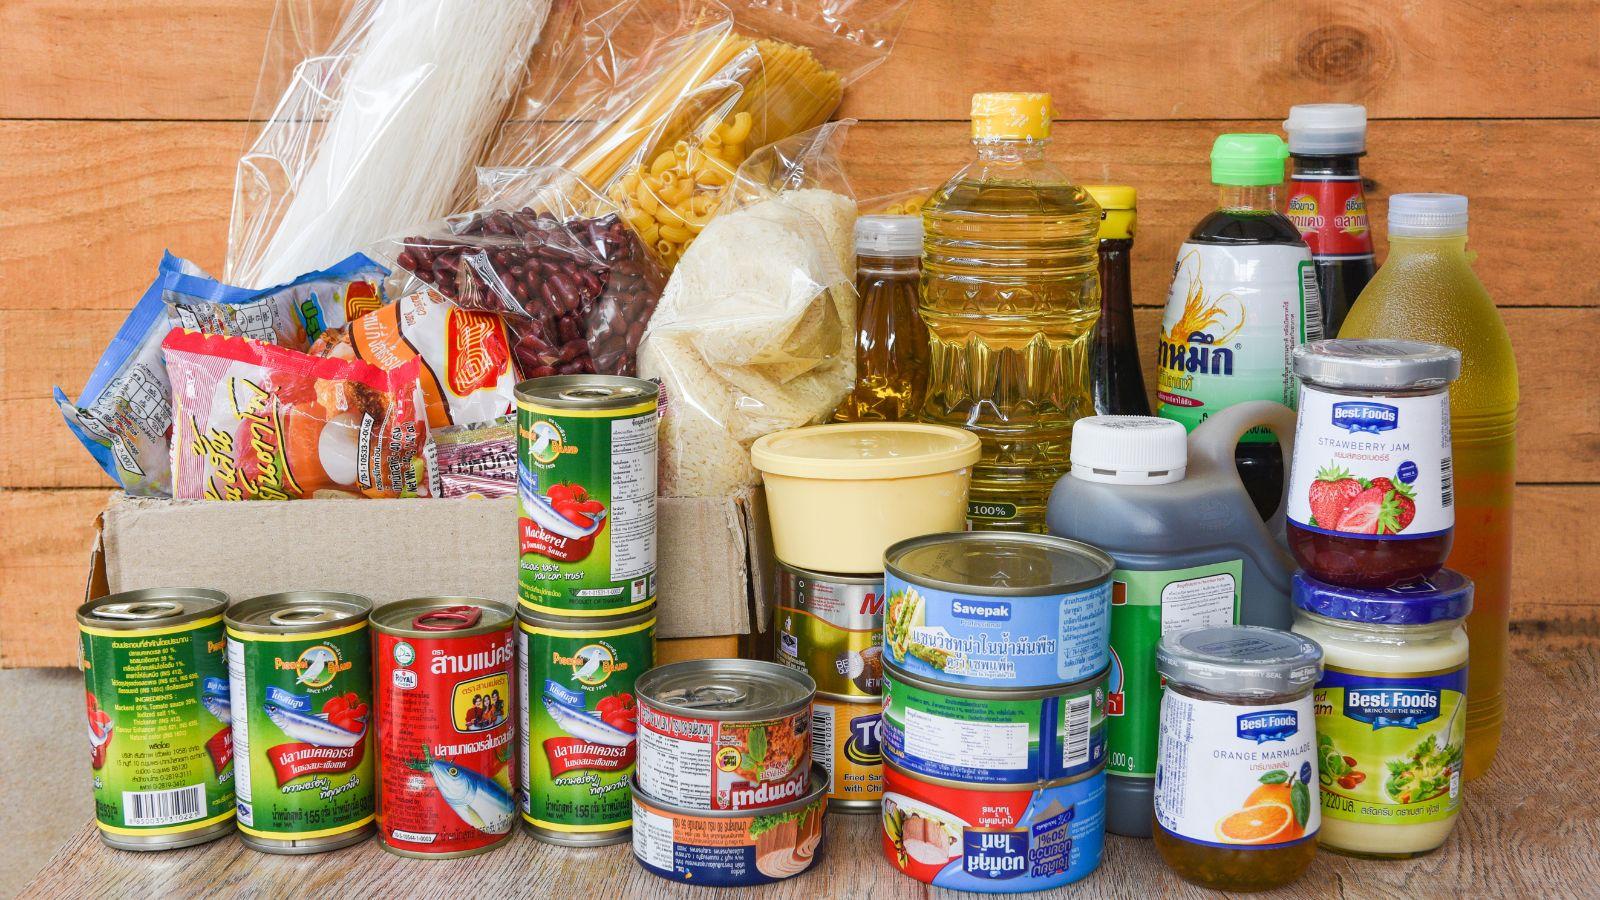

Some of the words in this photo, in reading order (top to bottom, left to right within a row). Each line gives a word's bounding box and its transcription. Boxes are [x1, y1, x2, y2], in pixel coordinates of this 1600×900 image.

[1335, 408, 1360, 419] Best
[1363, 408, 1396, 422] Foods
[1318, 437, 1386, 451] STRAWBERRY
[1390, 442, 1410, 452] JAM
[405, 482, 416, 492] Net
[974, 505, 1006, 516] 100%
[525, 525, 568, 549] Mackerel
[563, 571, 585, 580] trust
[953, 602, 1008, 617] Savepak
[395, 674, 414, 684] ROYAL
[1349, 692, 1389, 707] Best
[1393, 692, 1437, 708] Foods
[1240, 718, 1267, 731] Best
[1269, 715, 1296, 728] Foods
[1213, 750, 1257, 761] ORANGE
[1262, 743, 1311, 761] MARMALADE
[844, 773, 865, 783] Fried
[844, 784, 863, 793] with
[1326, 793, 1340, 810] 220
[304, 810, 320, 824] 155
[575, 805, 590, 818] 155
[982, 806, 1010, 817] ในน้ำแร่
[979, 815, 1014, 828] ทูน่าสเต็ก
[1040, 830, 1065, 846] 30%
